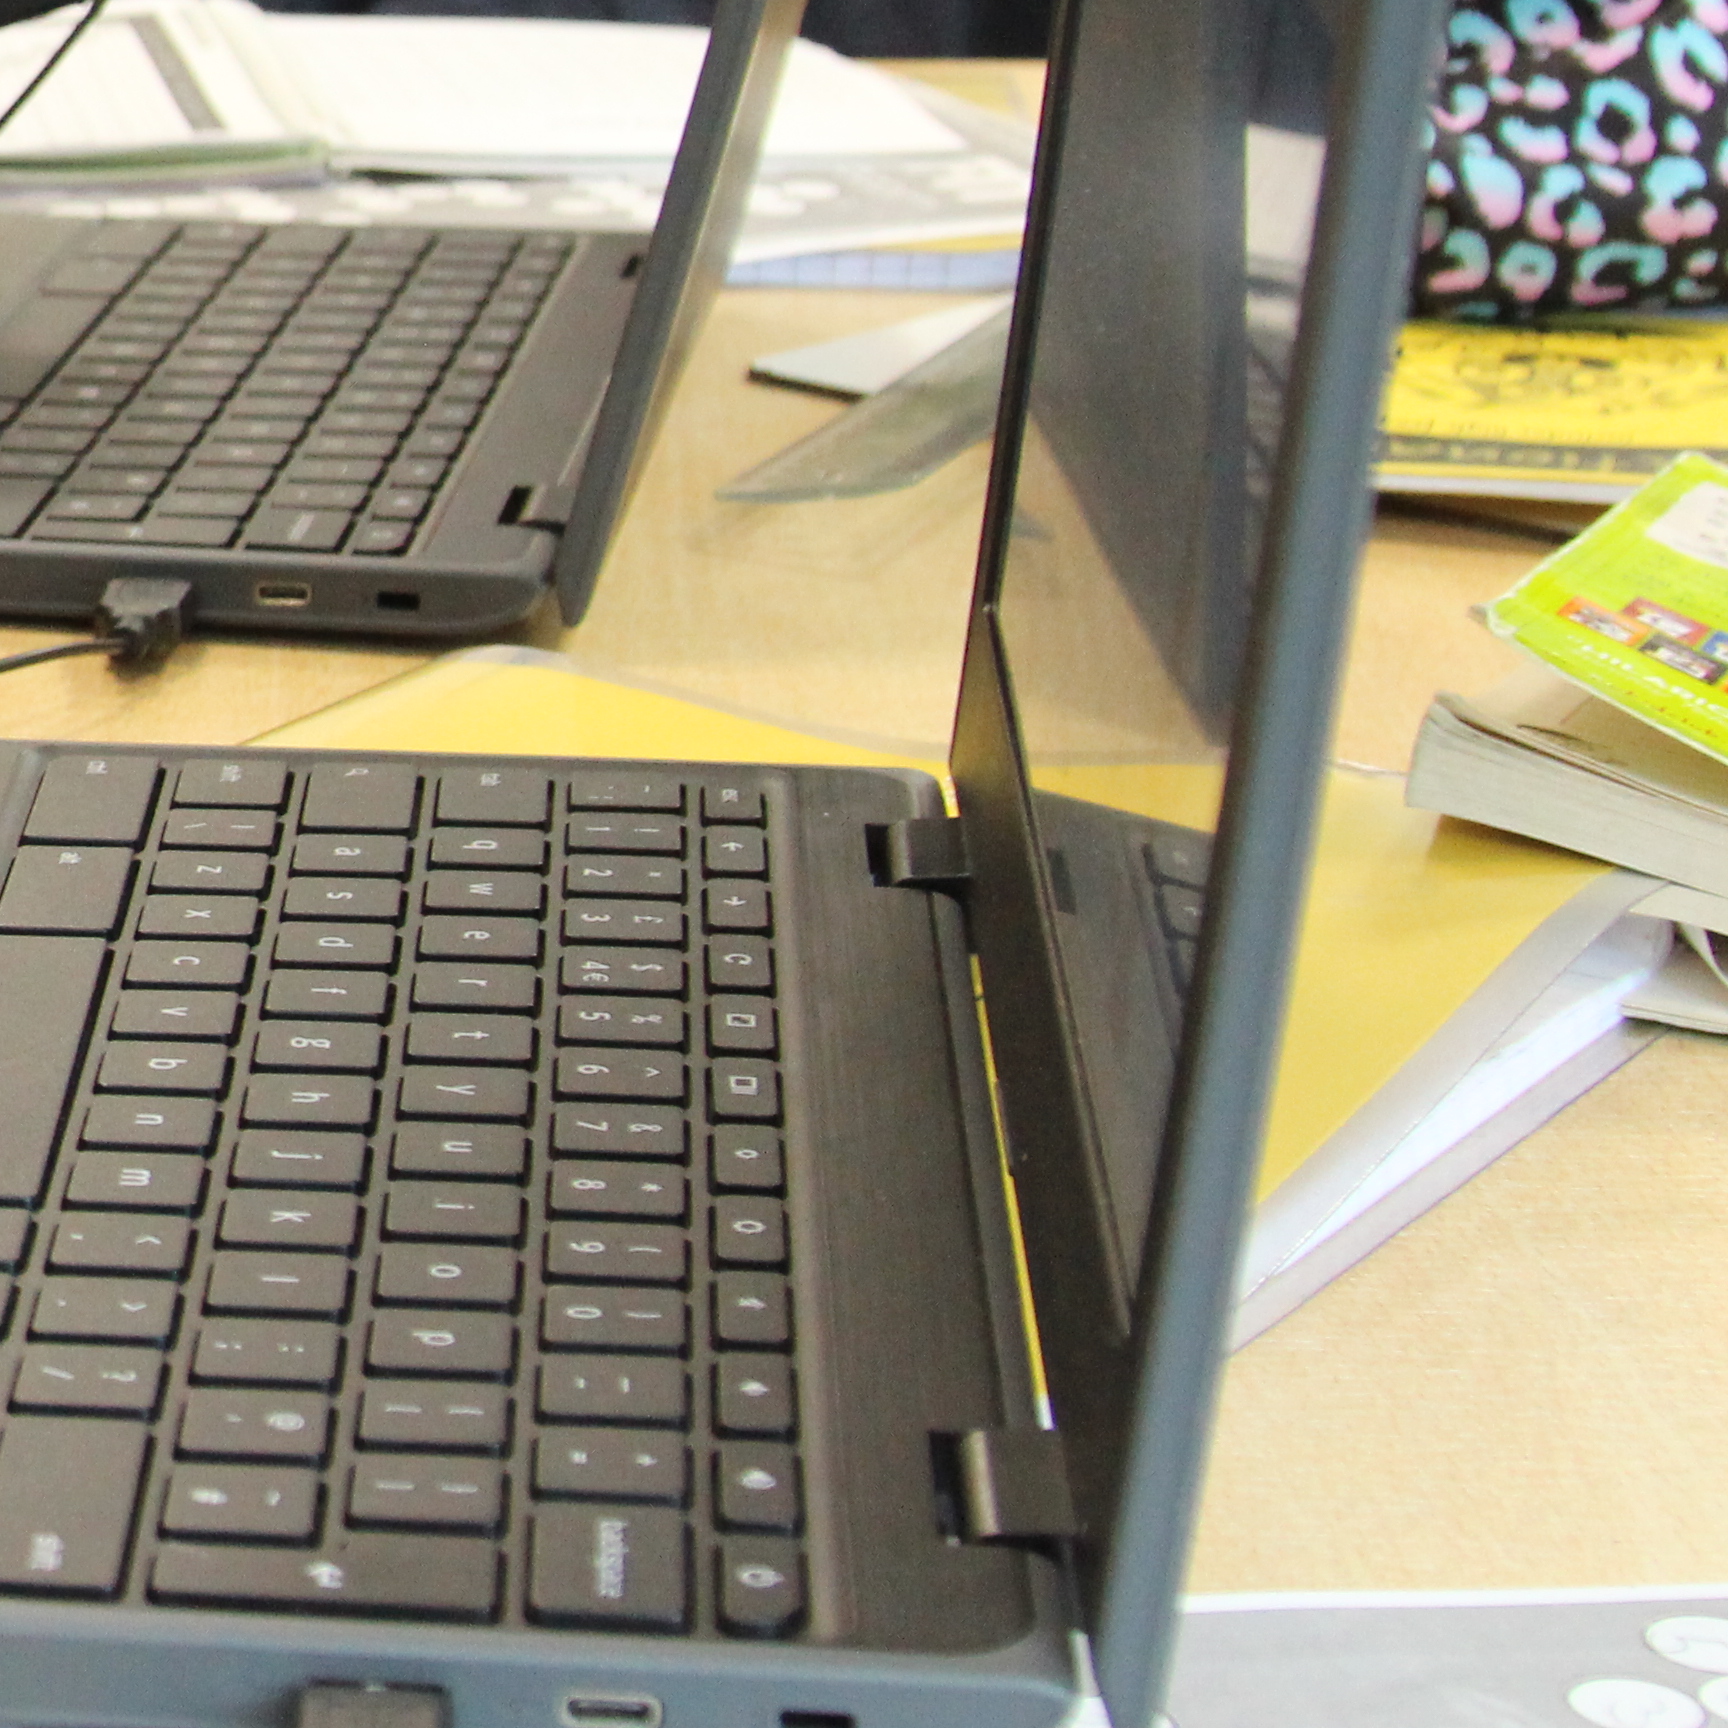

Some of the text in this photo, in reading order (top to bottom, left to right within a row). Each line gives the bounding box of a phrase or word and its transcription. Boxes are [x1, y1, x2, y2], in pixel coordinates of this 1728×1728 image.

[462, 839, 499, 850] q
[333, 846, 362, 857] a
[196, 864, 223, 874] z
[582, 867, 614, 877] 2
[469, 882, 493, 896] w
[326, 891, 354, 900] s
[185, 909, 211, 918] x
[579, 912, 611, 923] 3
[462, 930, 491, 941] e
[317, 936, 353, 948] d
[172, 955, 201, 966] c
[580, 960, 610, 972] 4
[458, 978, 488, 987] r
[310, 987, 347, 995] f
[160, 1006, 188, 1017] v
[577, 1010, 612, 1021] 5
[452, 1030, 489, 1040] t
[289, 1036, 332, 1049] g
[147, 1057, 187, 1070] b
[576, 1064, 610, 1075] 6
[435, 1084, 476, 1096] y
[291, 1091, 330, 1104] h
[134, 1113, 164, 1125] n
[575, 1120, 609, 1132] 7
[441, 1140, 472, 1153] u
[270, 1149, 323, 1161] j
[118, 1167, 151, 1187] m
[570, 1177, 607, 1190] 8
[434, 1202, 475, 1210] i
[270, 1210, 311, 1223] k
[568, 1240, 606, 1254] 9
[428, 1263, 462, 1279] o
[564, 1305, 603, 1320] 0
[411, 1329, 456, 1347] p
